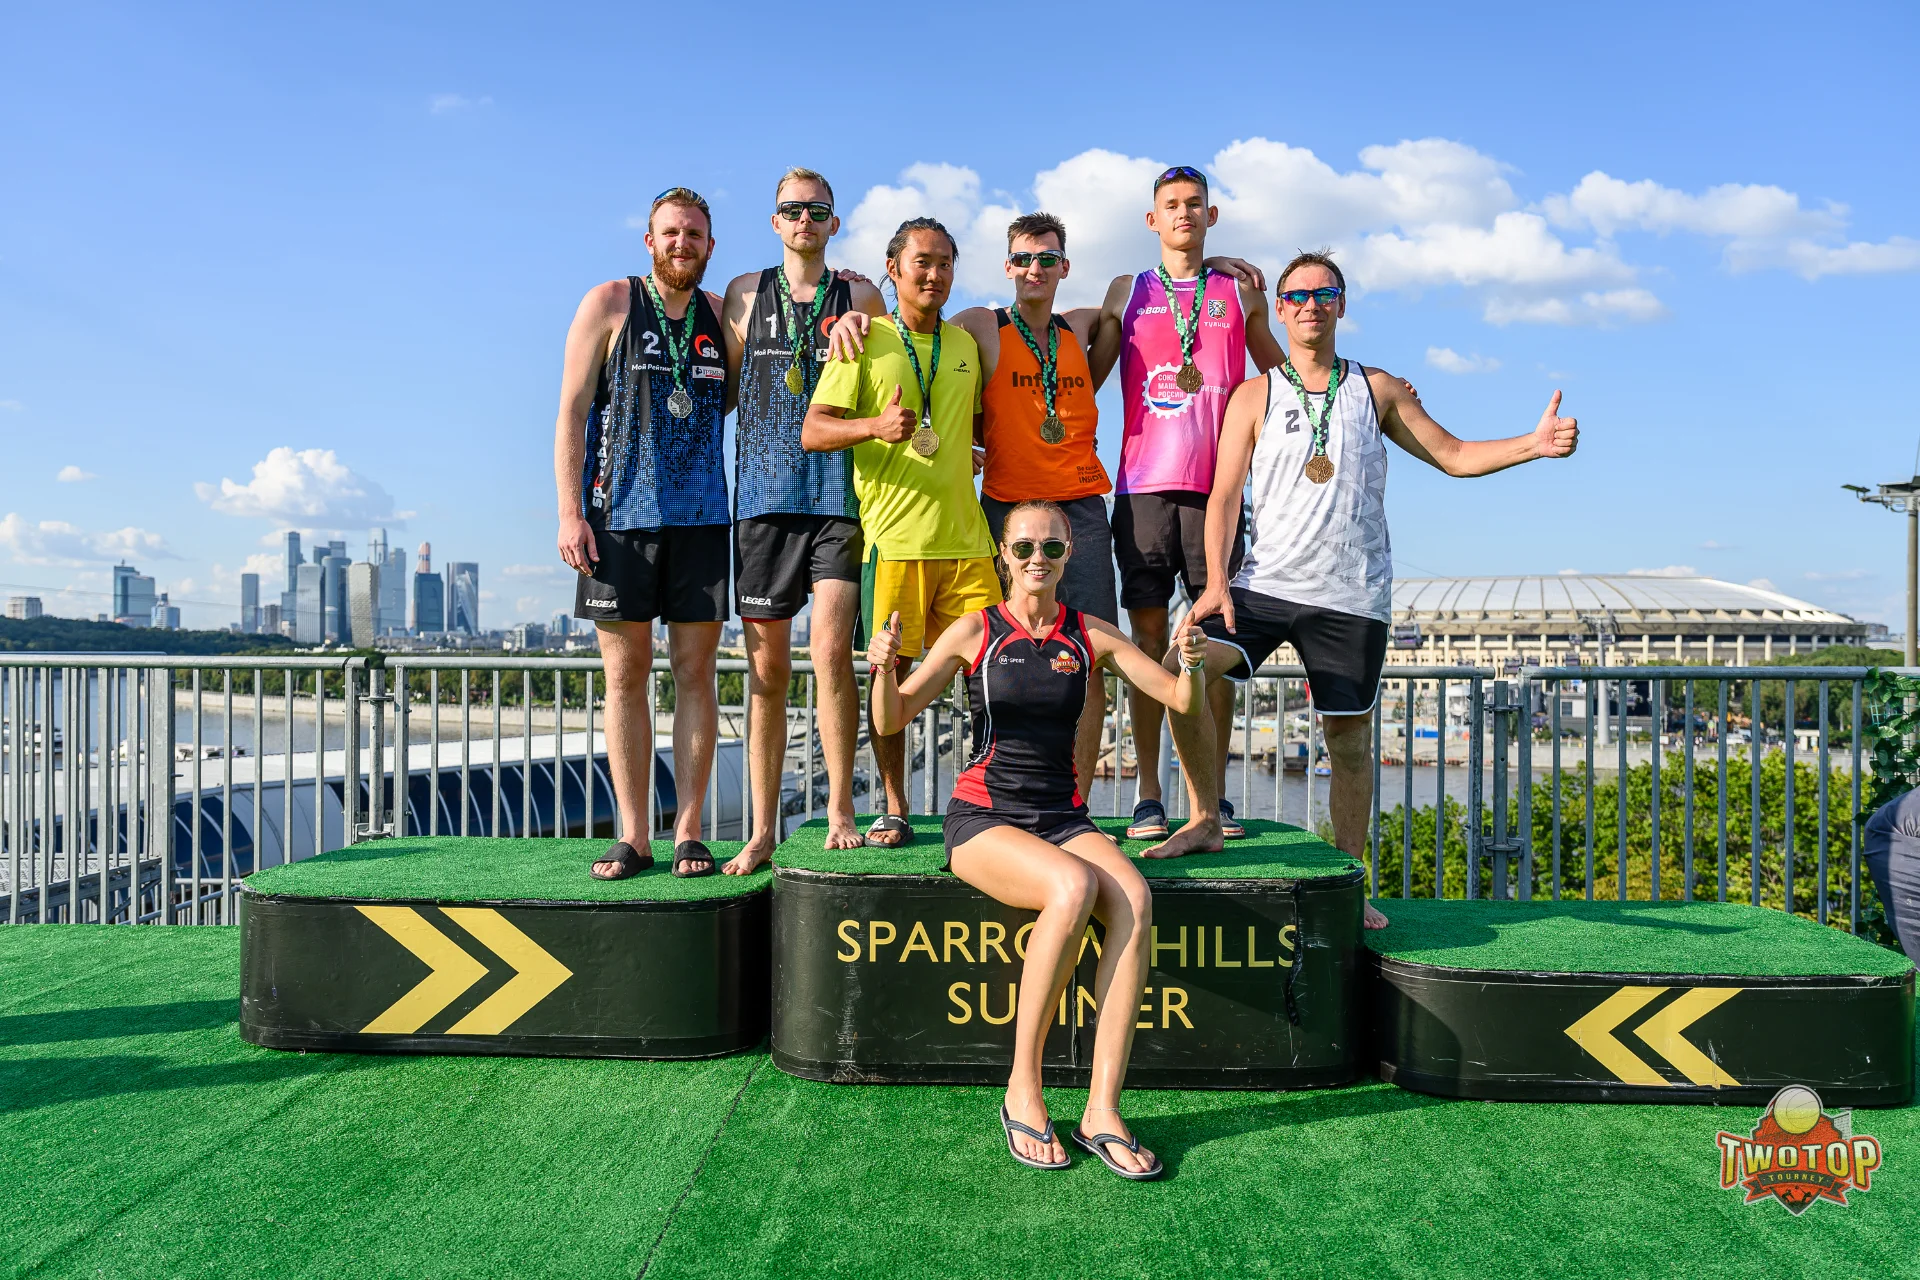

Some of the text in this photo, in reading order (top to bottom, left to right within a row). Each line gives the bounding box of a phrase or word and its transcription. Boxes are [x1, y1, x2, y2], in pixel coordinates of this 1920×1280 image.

[1145, 306, 1168, 315] ВФВ
[766, 312, 777, 338] 1
[642, 330, 661, 354] 2
[702, 347, 719, 359] sb
[753, 349, 766, 357] Мой
[631, 363, 646, 371] Мой
[1012, 371, 1085, 389] Infrno
[1157, 391, 1184, 399] РОССИИ
[1285, 409, 1300, 434] 2
[585, 598, 618, 609] LEGEA
[741, 595, 772, 606] LEGEA
[1150, 924, 1297, 968] HILLS
